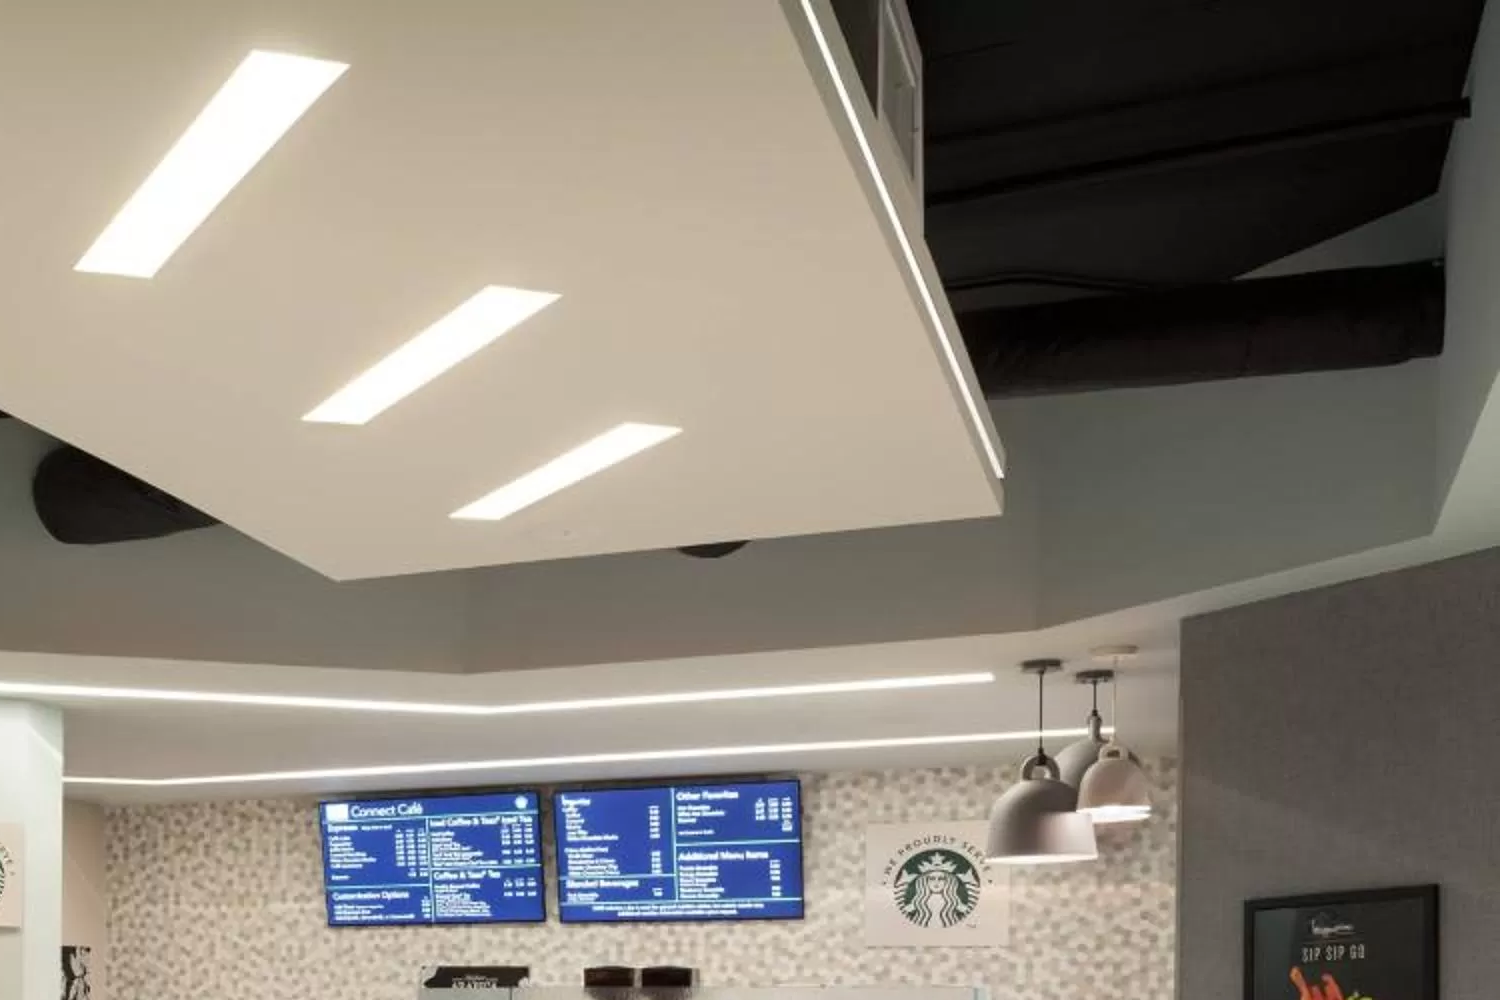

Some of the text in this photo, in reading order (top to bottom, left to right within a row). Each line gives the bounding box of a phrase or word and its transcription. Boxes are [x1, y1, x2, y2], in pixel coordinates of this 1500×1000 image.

[350, 802, 423, 818] Connect Café
[898, 835, 956, 855] PROUDLY
[1301, 944, 1365, 963] SIP SIP GO
